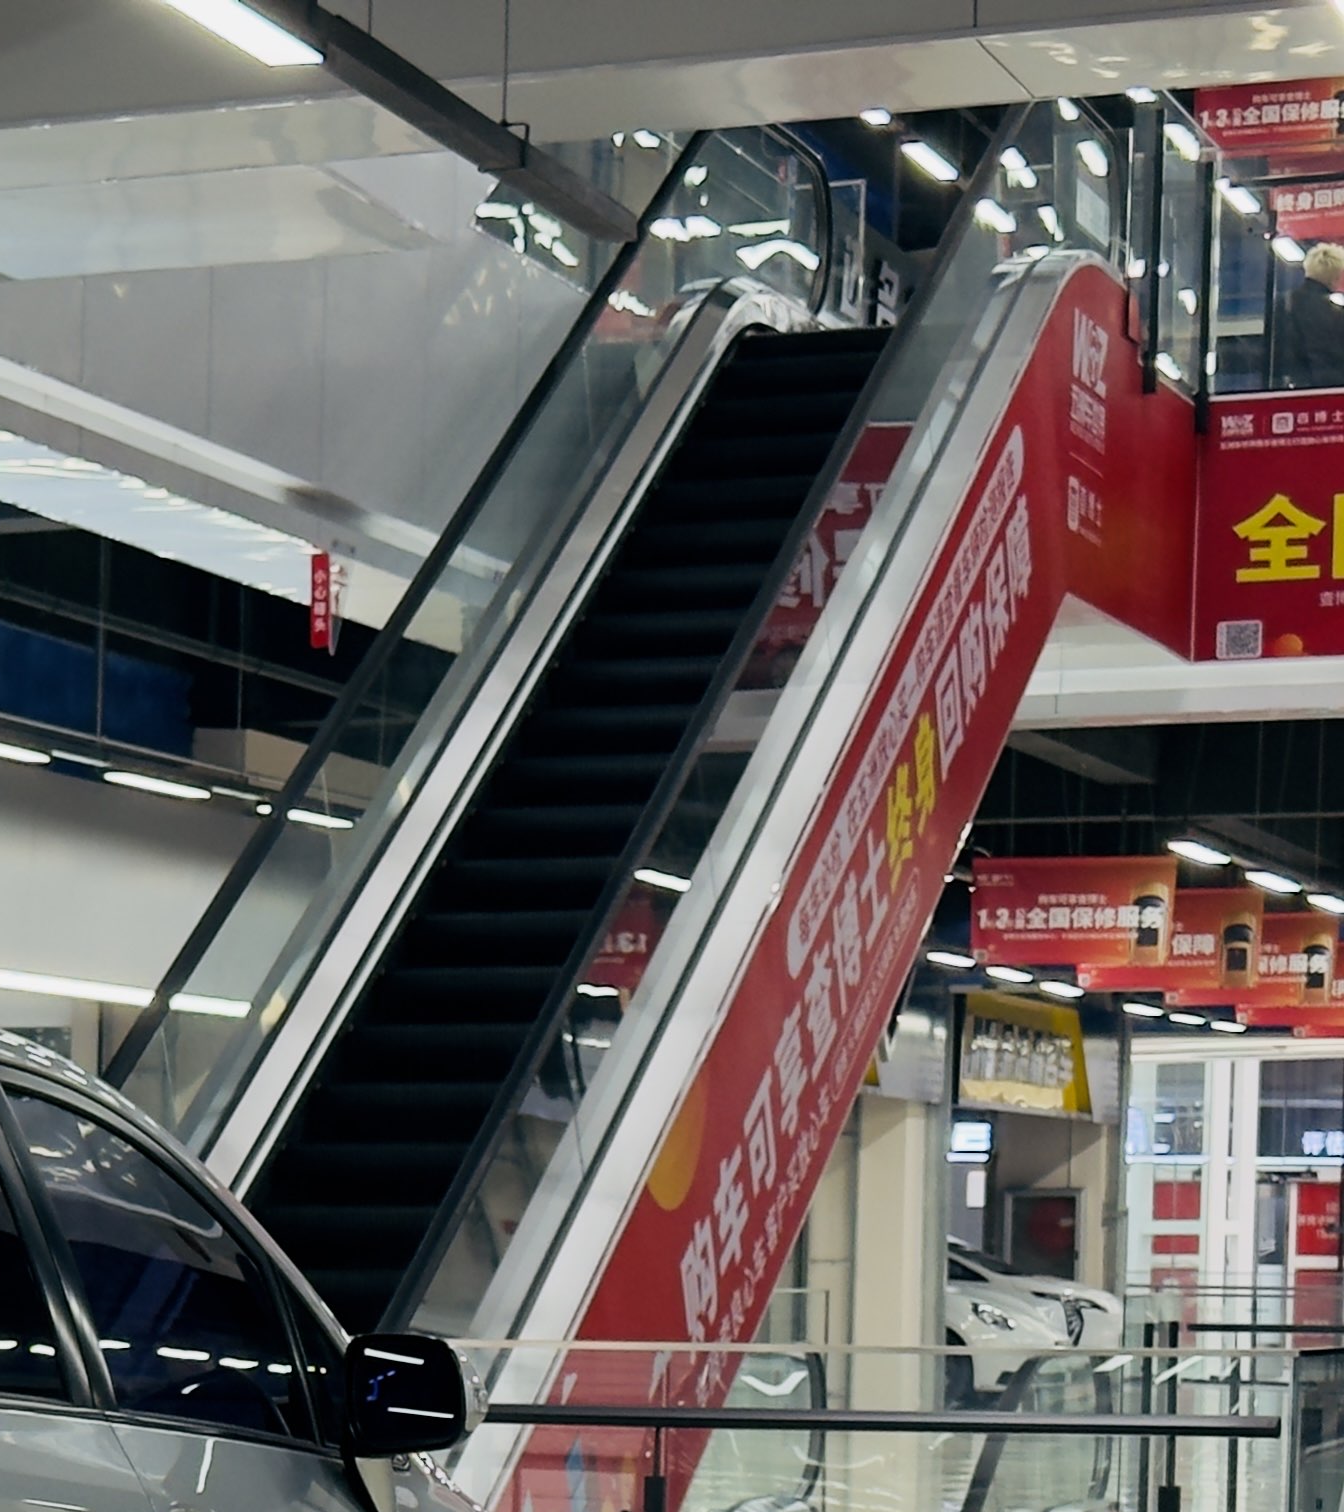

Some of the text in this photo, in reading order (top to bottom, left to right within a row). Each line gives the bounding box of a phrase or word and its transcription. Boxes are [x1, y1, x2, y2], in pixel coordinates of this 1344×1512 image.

[1232, 493, 1344, 583] 全
[680, 493, 1032, 1366] 购车可享查博士终身回购保障
